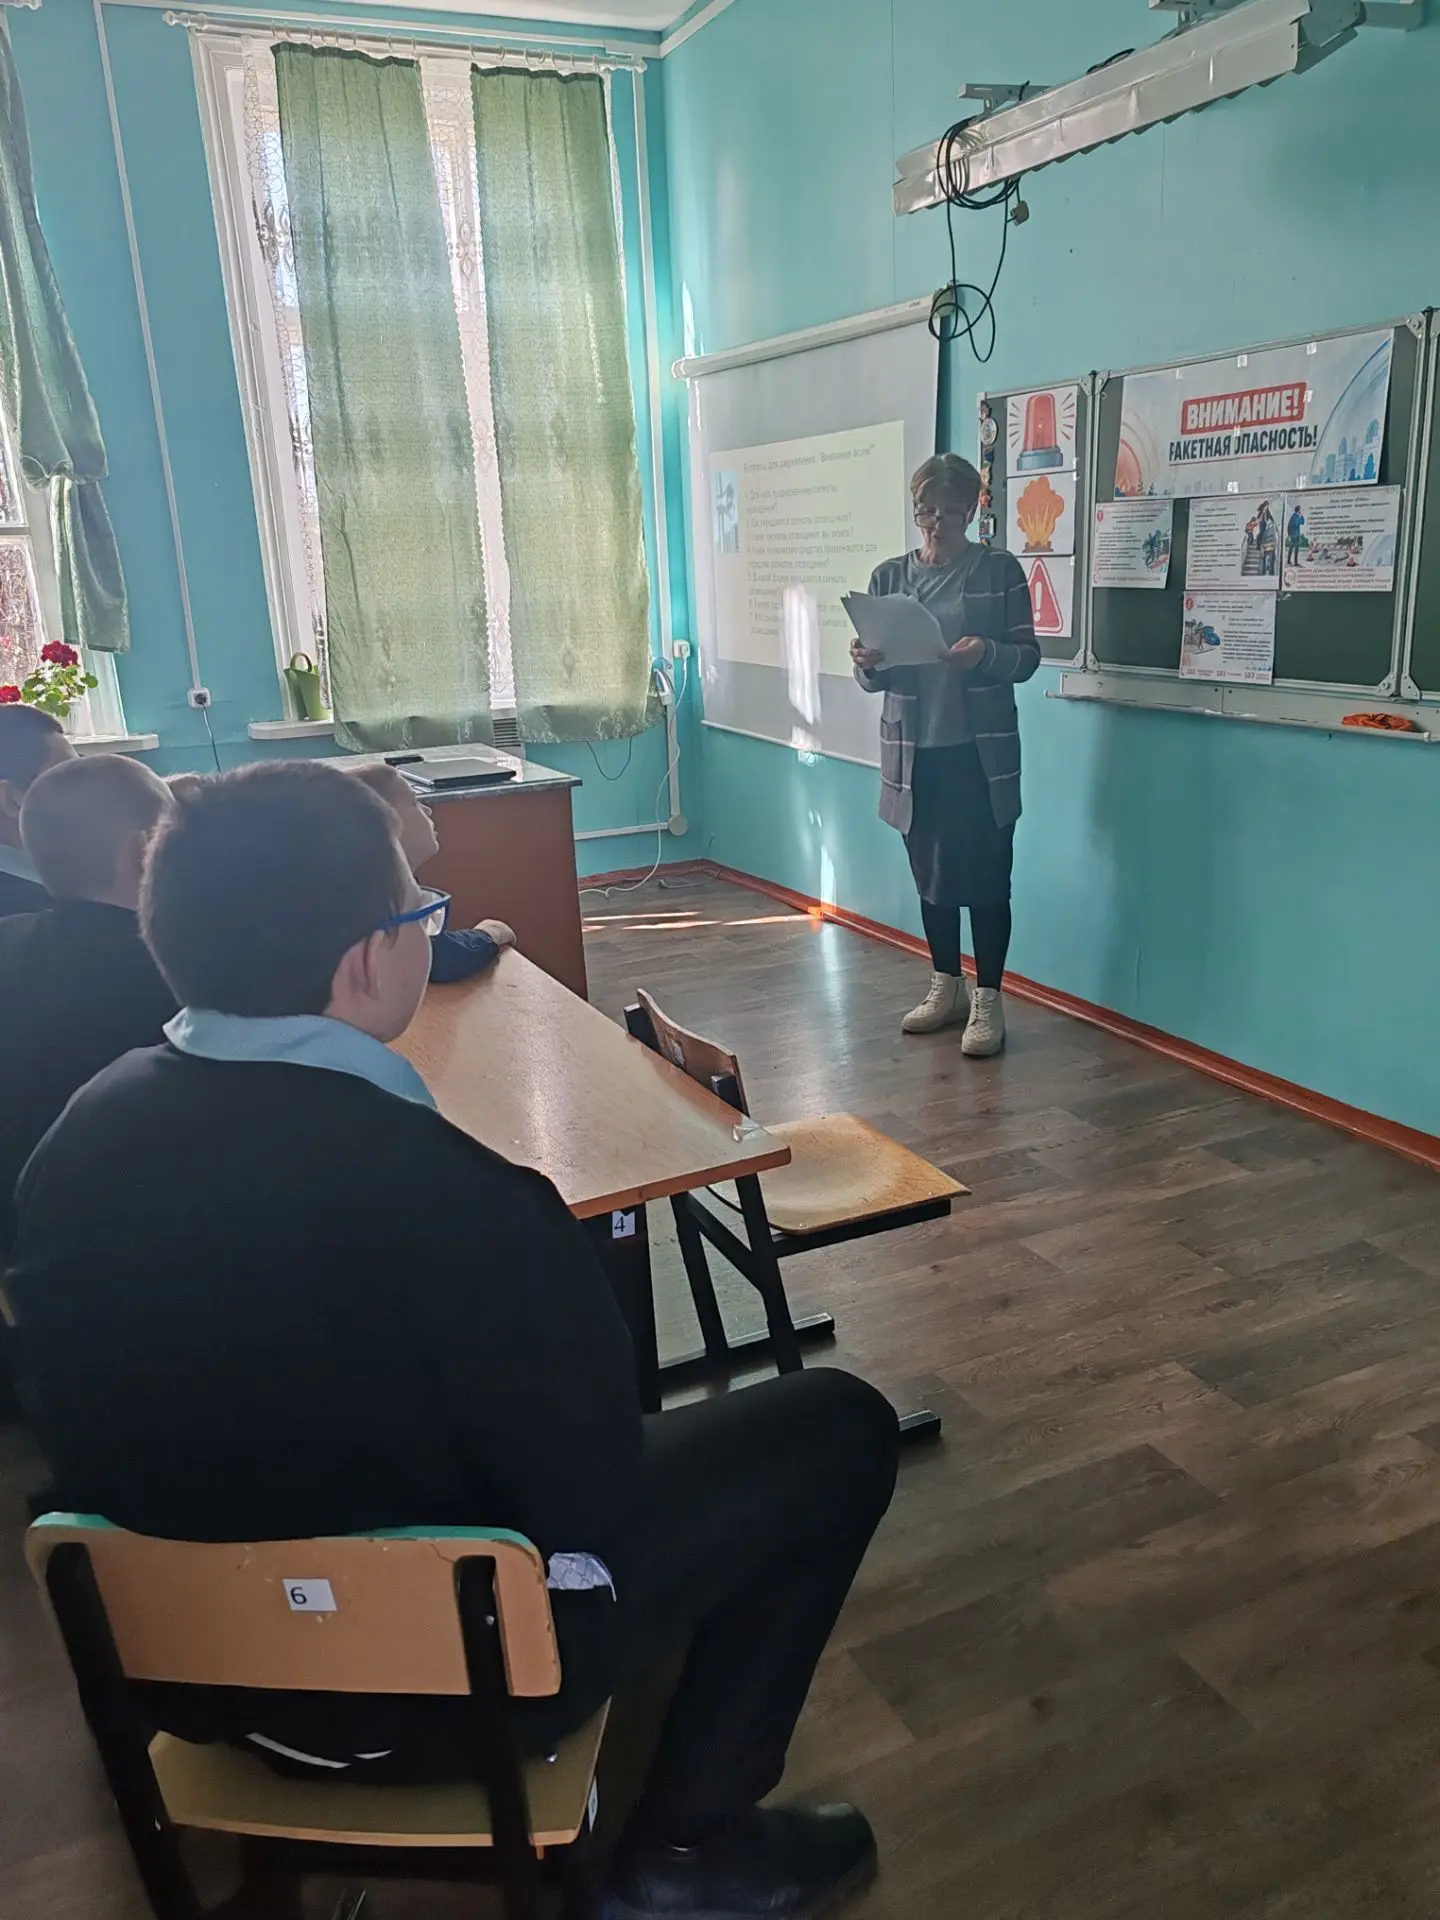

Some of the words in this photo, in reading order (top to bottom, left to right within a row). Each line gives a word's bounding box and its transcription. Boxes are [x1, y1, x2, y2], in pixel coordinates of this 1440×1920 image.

[1187, 388, 1300, 430] ВНИМАНИЕ!
[614, 1216, 626, 1232] 4
[290, 1586, 307, 1605] 6
